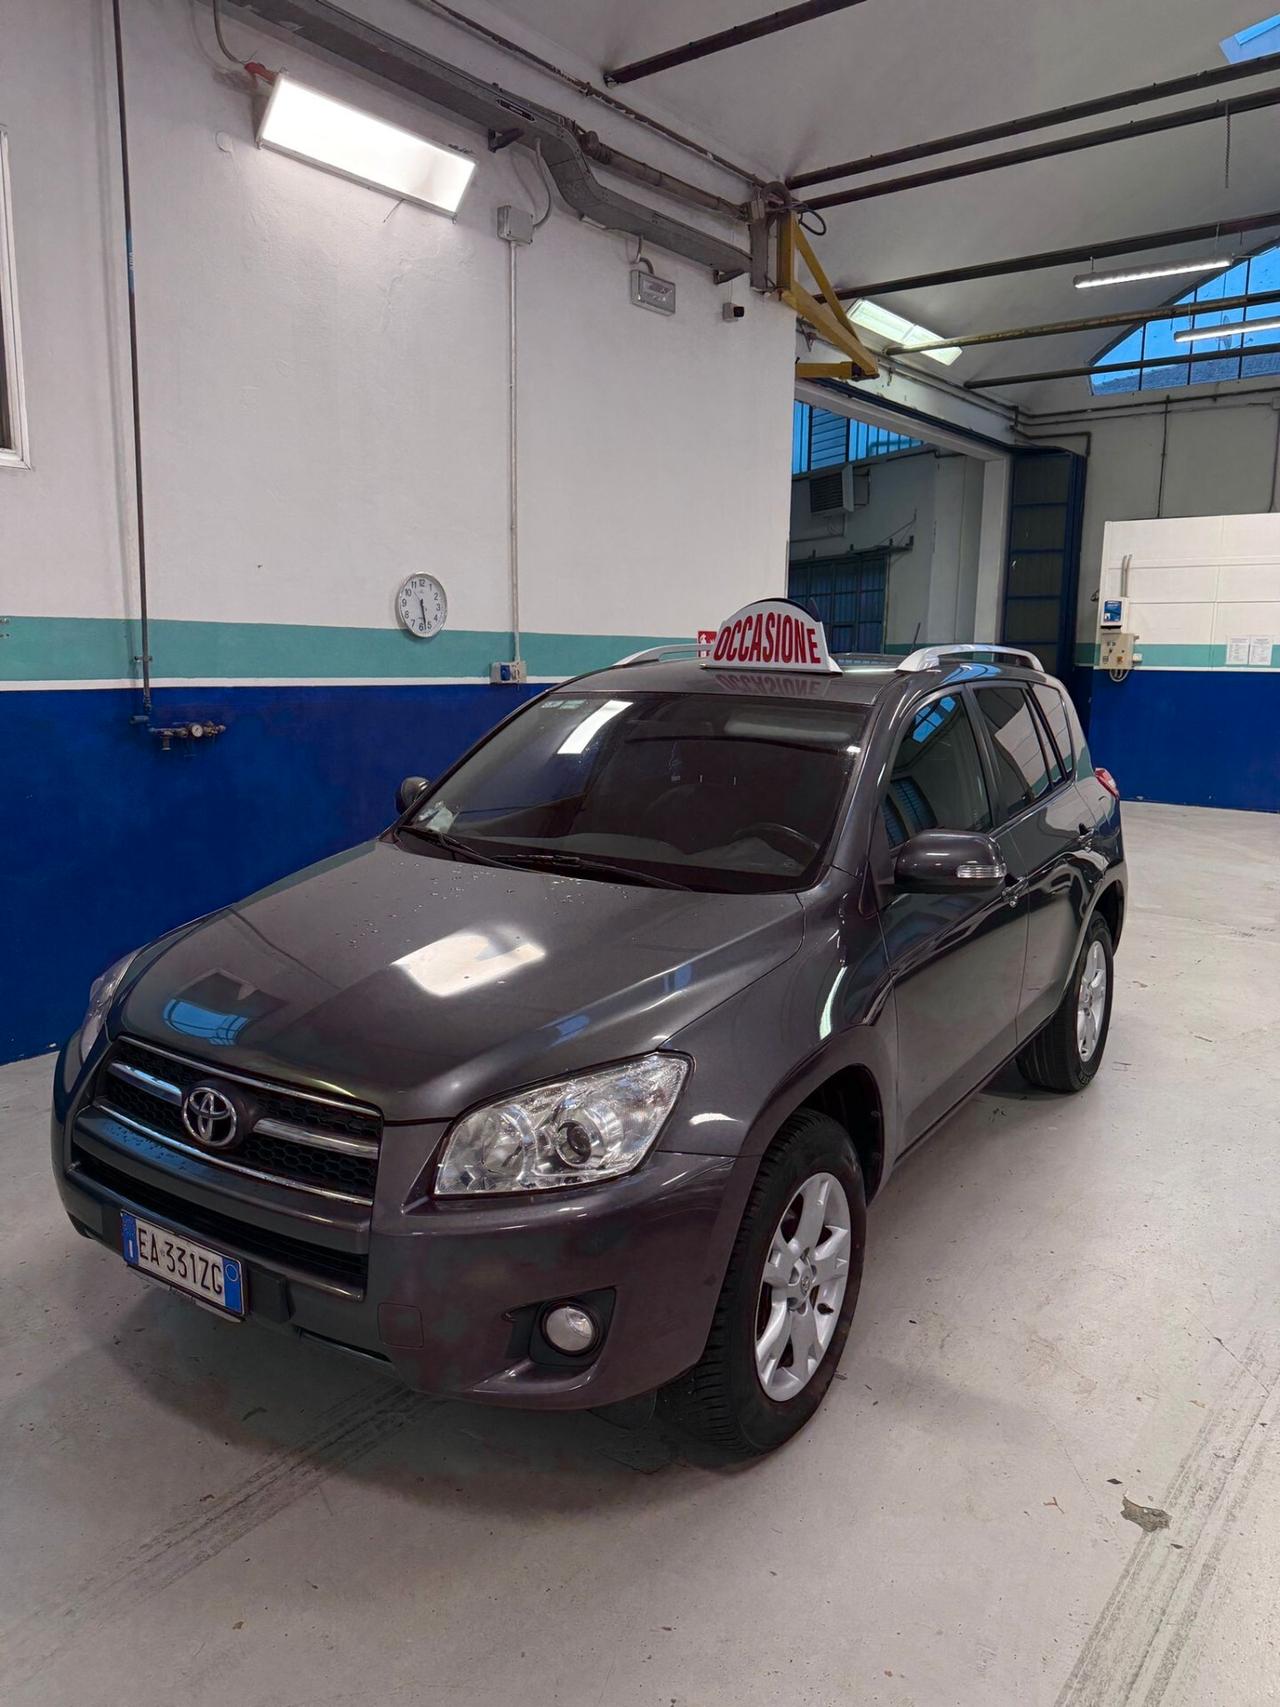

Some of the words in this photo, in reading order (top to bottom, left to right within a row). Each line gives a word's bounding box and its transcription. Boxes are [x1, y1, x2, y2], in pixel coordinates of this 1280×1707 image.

[411, 581, 417, 589] 11
[419, 579, 425, 587] 12
[429, 583, 432, 591] 1
[405, 588, 412, 597] 10
[434, 592, 439, 601] 2
[402, 598, 407, 607] 9
[436, 603, 441, 611] 3
[405, 610, 410, 619] 8
[434, 614, 438, 622] 4
[411, 619, 415, 628] 7
[419, 623, 424, 631] 6
[427, 621, 432, 630] 5
[713, 612, 821, 664] OCCASIONE
[138, 1227, 159, 1267] EA
[165, 1241, 223, 1295] 331ZG
